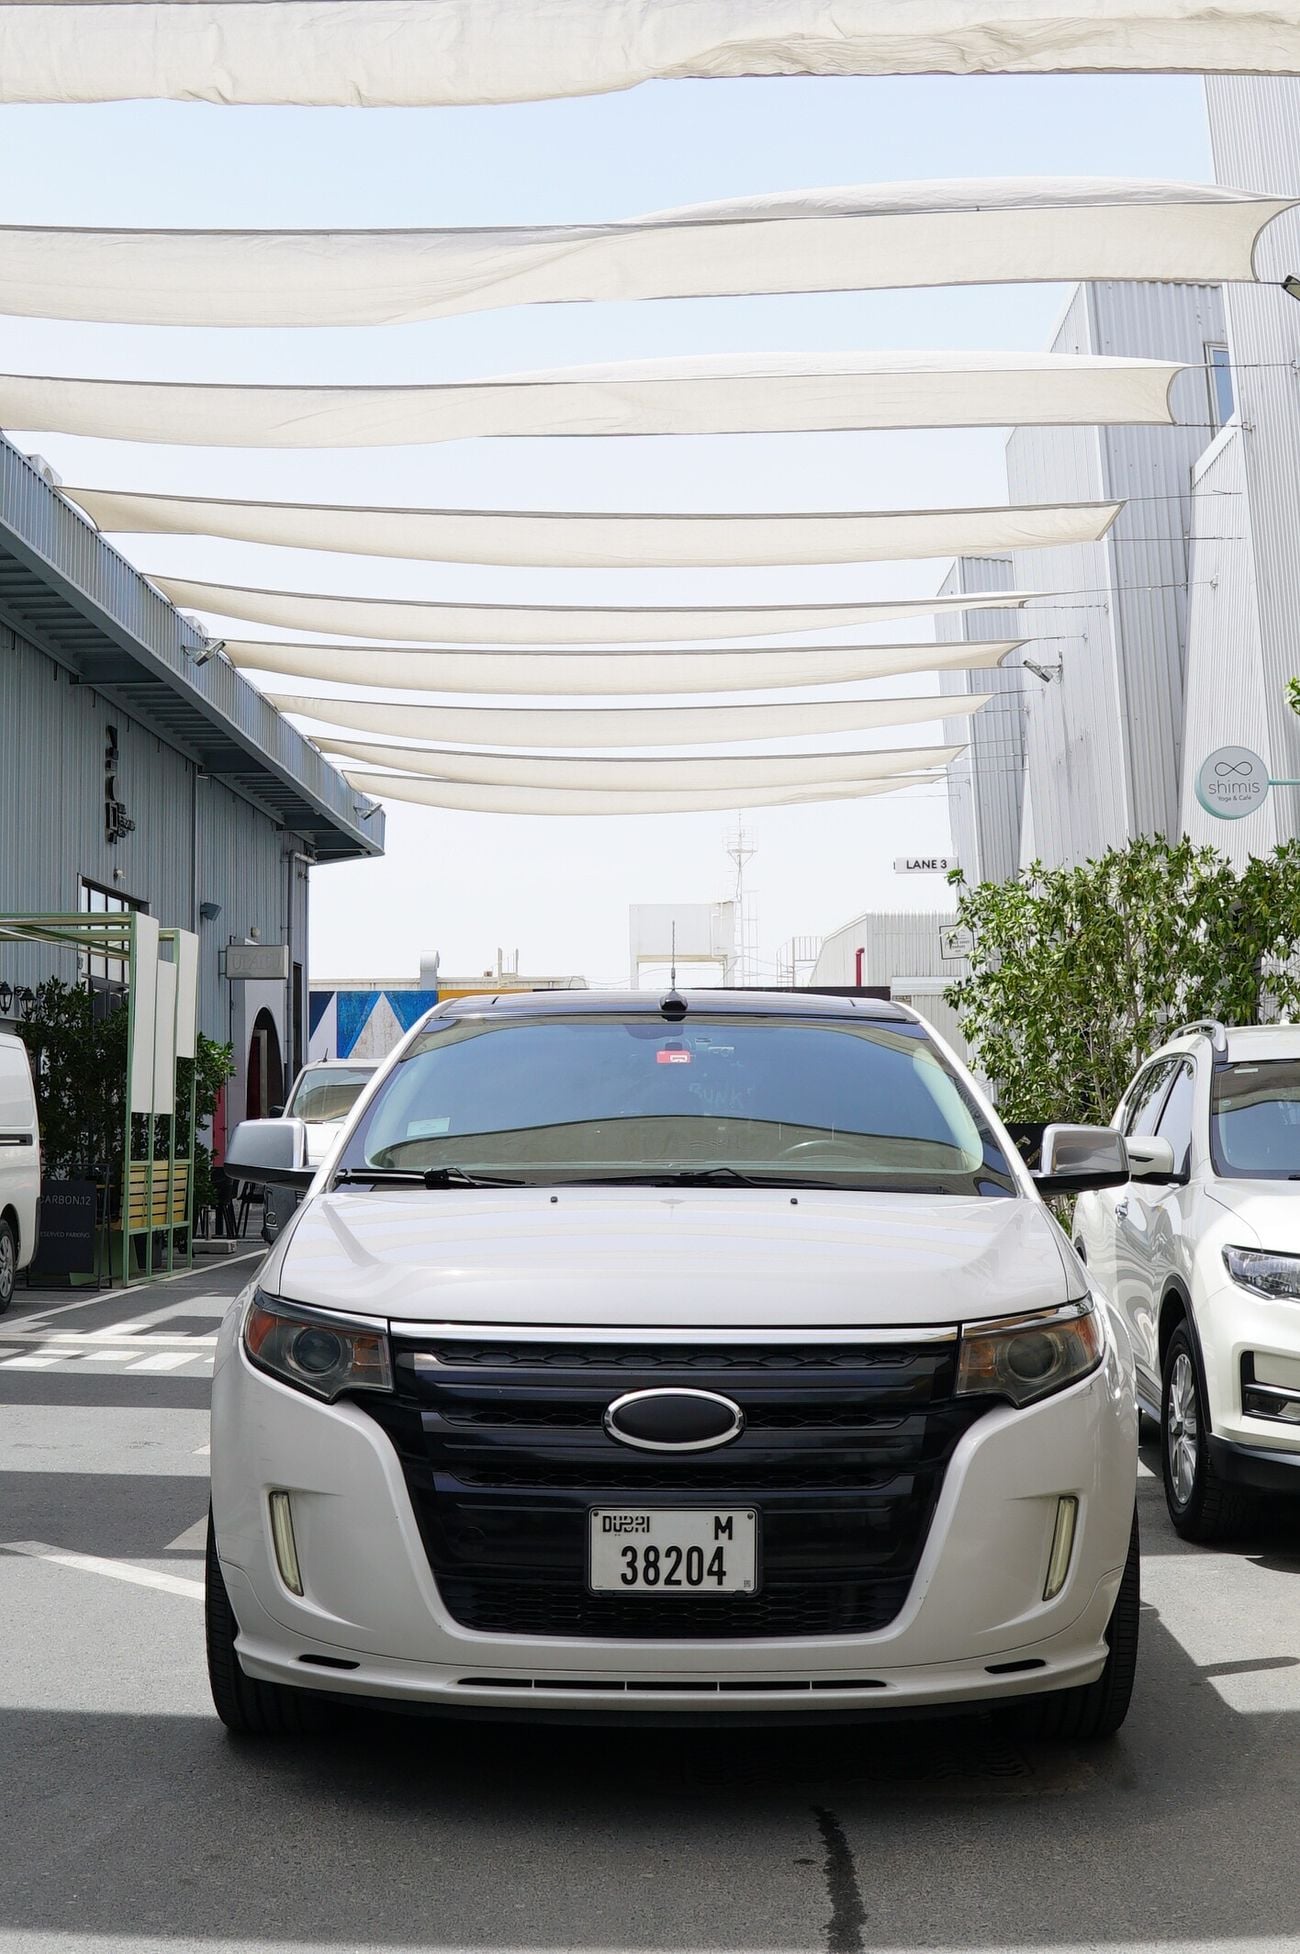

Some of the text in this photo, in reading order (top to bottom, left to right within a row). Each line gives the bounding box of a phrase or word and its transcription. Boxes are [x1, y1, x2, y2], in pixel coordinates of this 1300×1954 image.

[1208, 779, 1261, 795] shimis
[906, 859, 948, 870] LANE 3
[714, 1516, 733, 1541] M
[620, 1545, 727, 1586] 38204
